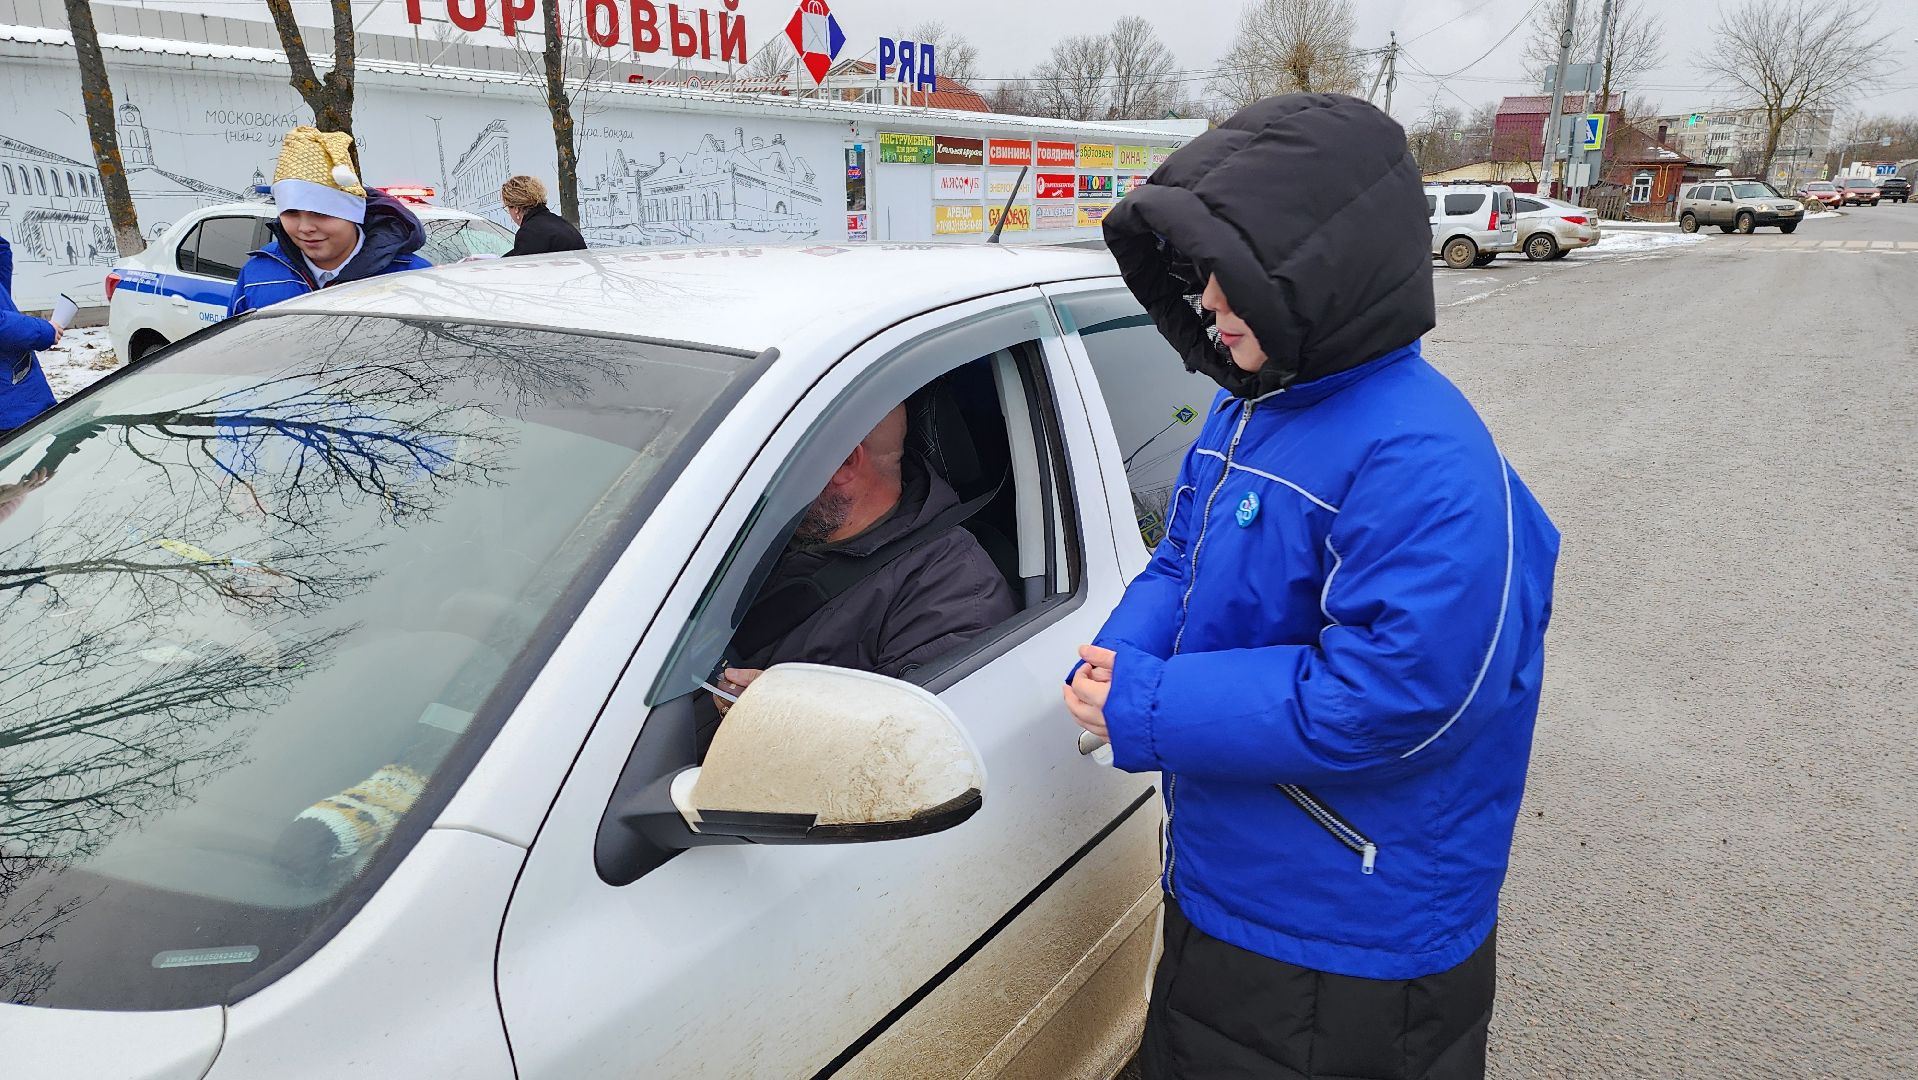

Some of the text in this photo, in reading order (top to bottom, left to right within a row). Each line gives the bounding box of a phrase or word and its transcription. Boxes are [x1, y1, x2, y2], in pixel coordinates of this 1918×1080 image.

[406, 0, 748, 65] ОРОВЫЙ
[879, 37, 937, 92] РЯД
[205, 109, 298, 128] МОСКОВСКАЯ
[879, 132, 934, 147] ИНСТРУМЕНТЫ
[989, 146, 1031, 160] СВИНИНА
[1037, 147, 1075, 161] ГОВЯДИНА
[1120, 150, 1141, 165] ОКНА
[990, 183, 1030, 193] ЭНЕРГОГАНТ
[1080, 175, 1113, 190] ШТОРЫ
[946, 207, 972, 220] АРЕНДА
[988, 208, 1030, 229] САОВОД
[199, 312, 219, 323] ОМВД
